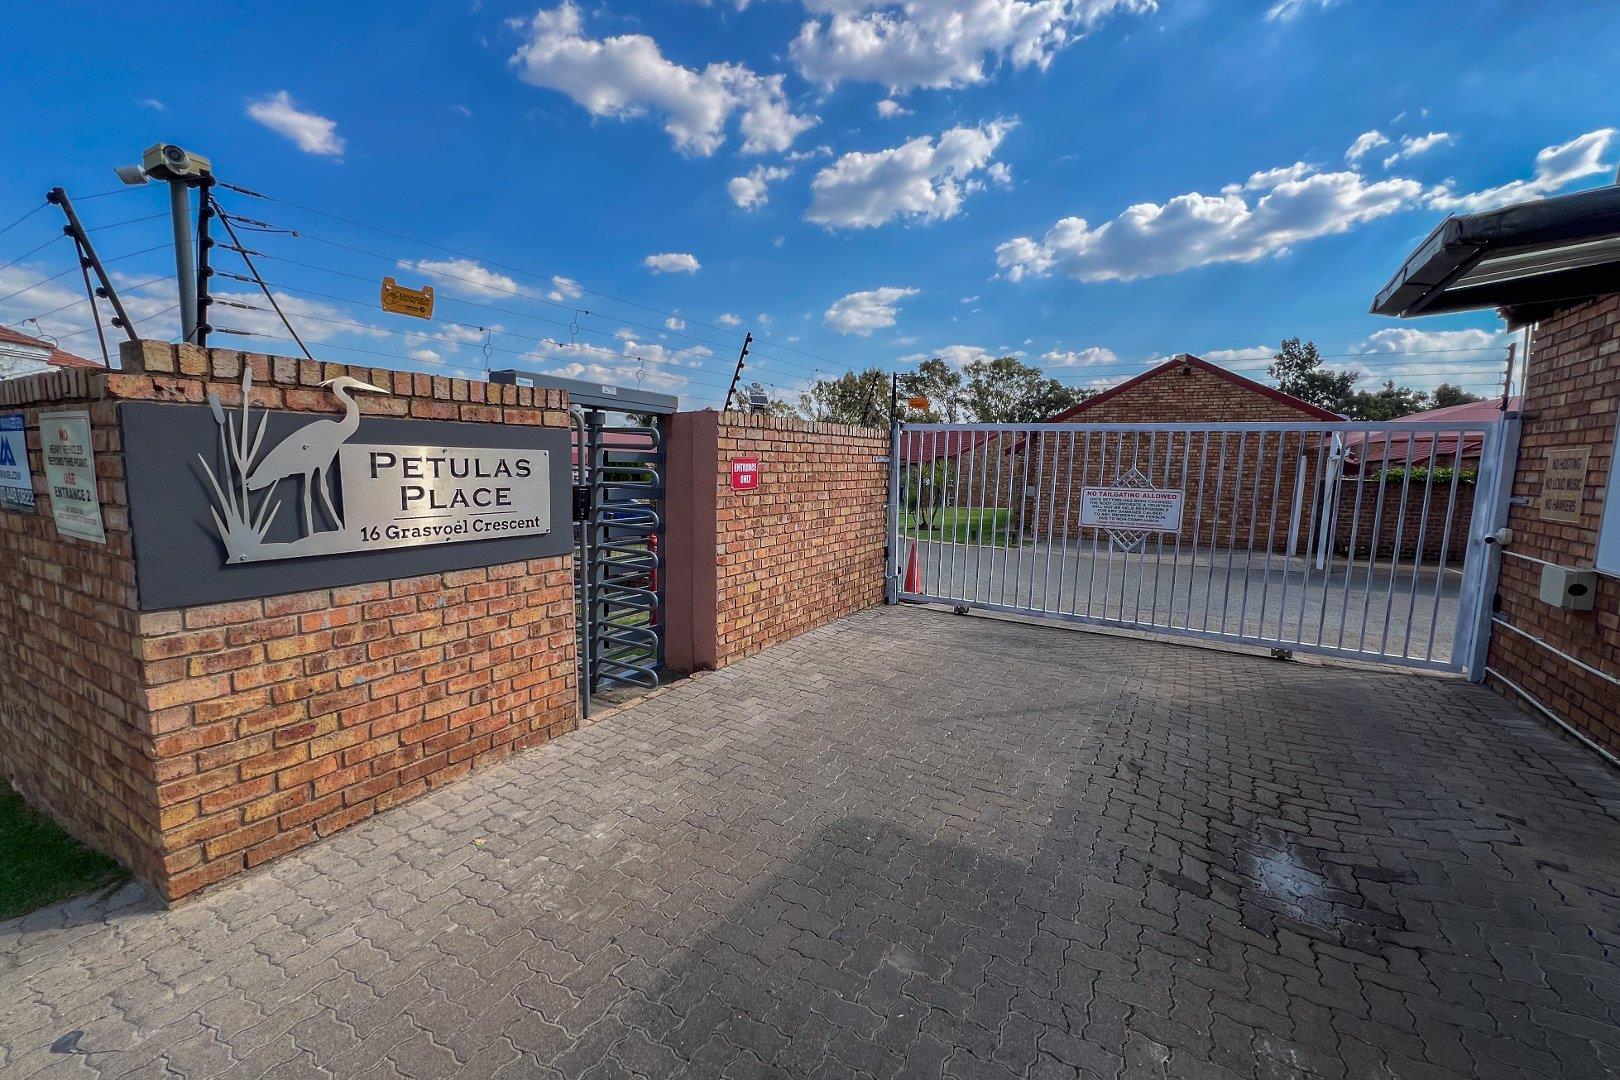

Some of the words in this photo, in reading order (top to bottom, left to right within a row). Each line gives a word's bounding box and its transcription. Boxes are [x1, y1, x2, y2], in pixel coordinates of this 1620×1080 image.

[59, 429, 68, 442] NO
[368, 452, 532, 479] PETULAS
[734, 463, 756, 472] ENTRANCE
[64, 472, 76, 486] USE
[54, 486, 86, 502] ENTRANCE
[86, 490, 92, 502] 2
[400, 486, 512, 510] PLACE
[360, 526, 380, 542] 16
[472, 516, 540, 532] Crescent
